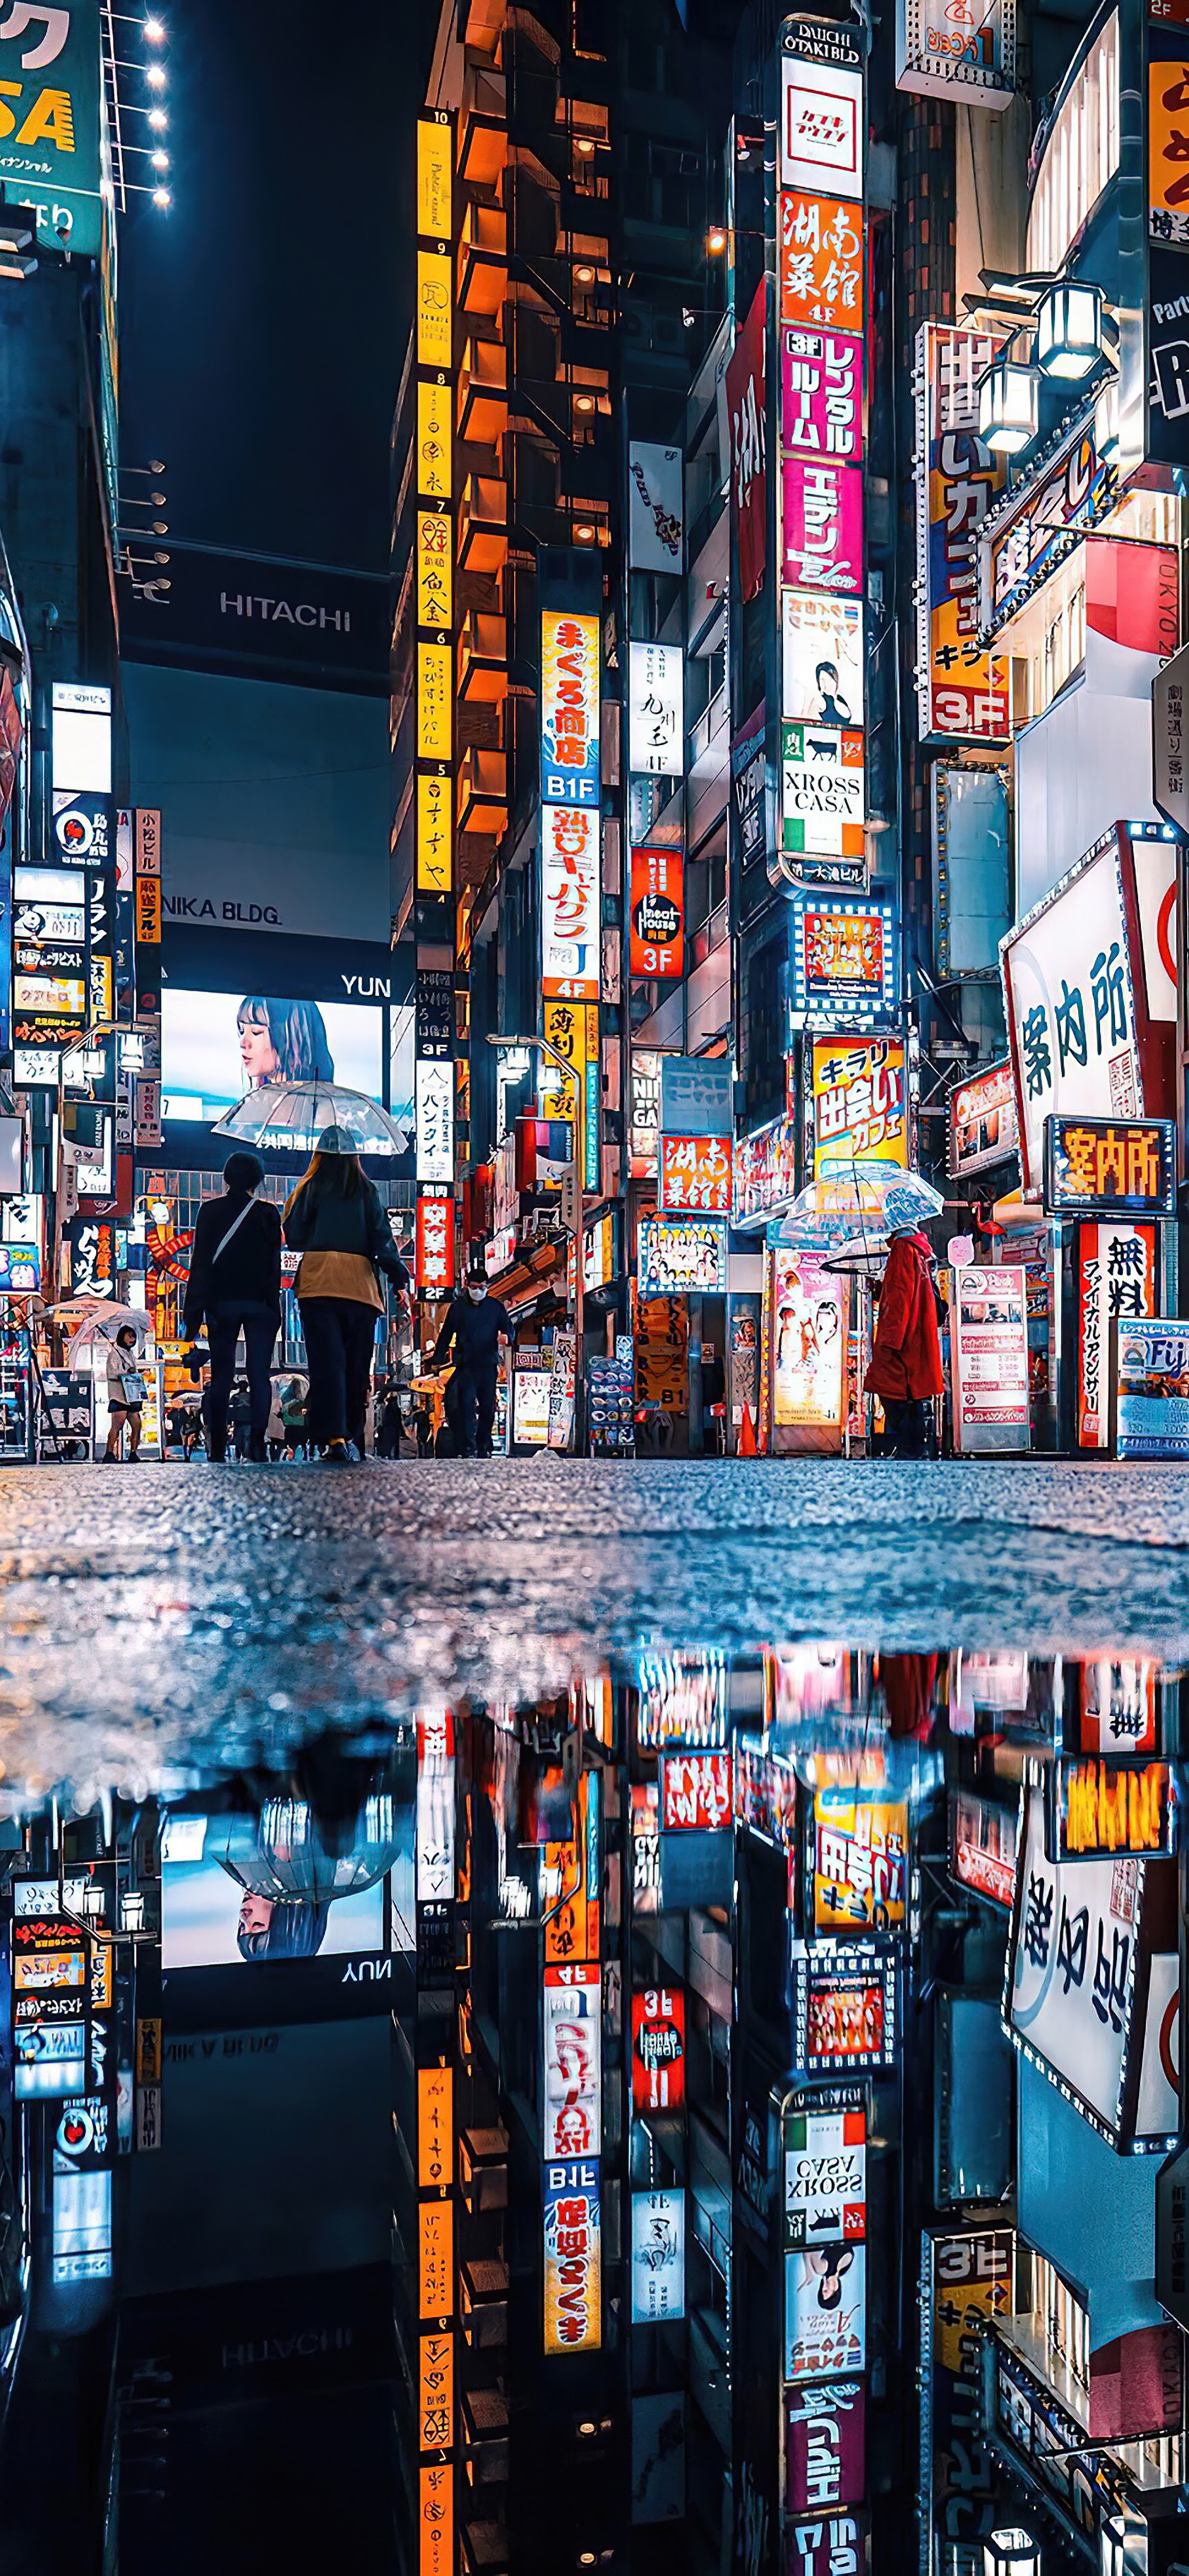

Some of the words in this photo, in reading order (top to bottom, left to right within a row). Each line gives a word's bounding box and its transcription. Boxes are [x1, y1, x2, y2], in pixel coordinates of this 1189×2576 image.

[434, 111, 448, 124] 10
[437, 243, 445, 254] 9
[792, 334, 821, 355] 3F
[791, 361, 821, 450] ルーム
[825, 337, 855, 454] レンタル
[437, 501, 445, 514] 7
[1159, 550, 1177, 633] OKYO
[220, 592, 351, 632] HITACHI
[437, 632, 446, 644] 6
[555, 621, 586, 766] まぐろ商店
[935, 691, 1006, 732] 3F
[438, 764, 446, 776] 5
[547, 776, 595, 799] B1F
[785, 772, 860, 796] XROSS
[794, 792, 853, 815] CASA
[643, 948, 672, 972] 3F
[341, 975, 391, 997] YUN
[557, 979, 585, 997] 4F
[1022, 941, 1127, 1101] 案内所
[422, 1043, 448, 1056] 3F
[820, 1040, 888, 1084] キラリ
[817, 1066, 898, 1134] 出会い
[852, 1114, 903, 1156] カフェ
[1107, 1236, 1144, 1317] 無料
[425, 1287, 445, 1300] 2F
[1083, 1260, 1101, 1411] ファイナルアンサー
